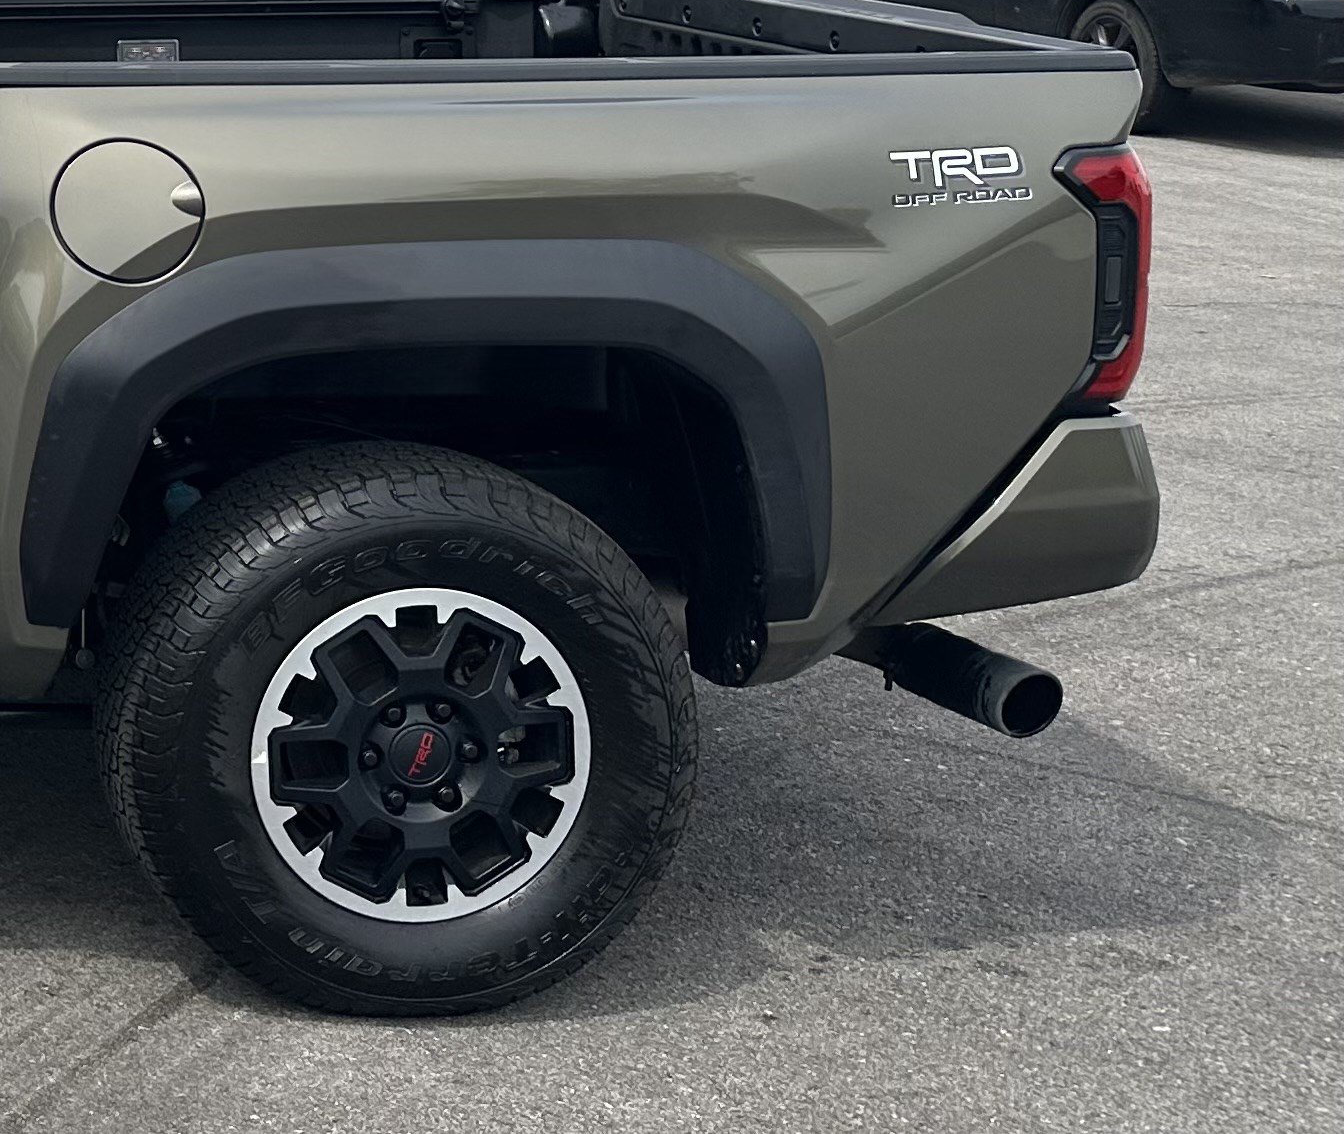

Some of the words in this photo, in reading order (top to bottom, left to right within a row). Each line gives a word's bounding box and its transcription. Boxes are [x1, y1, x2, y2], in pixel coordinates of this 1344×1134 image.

[889, 146, 1020, 187] TRD
[891, 192, 948, 208] OFF
[953, 187, 1033, 205] ROAD
[237, 535, 605, 660] BFGoodrich
[408, 731, 433, 777] TRD
